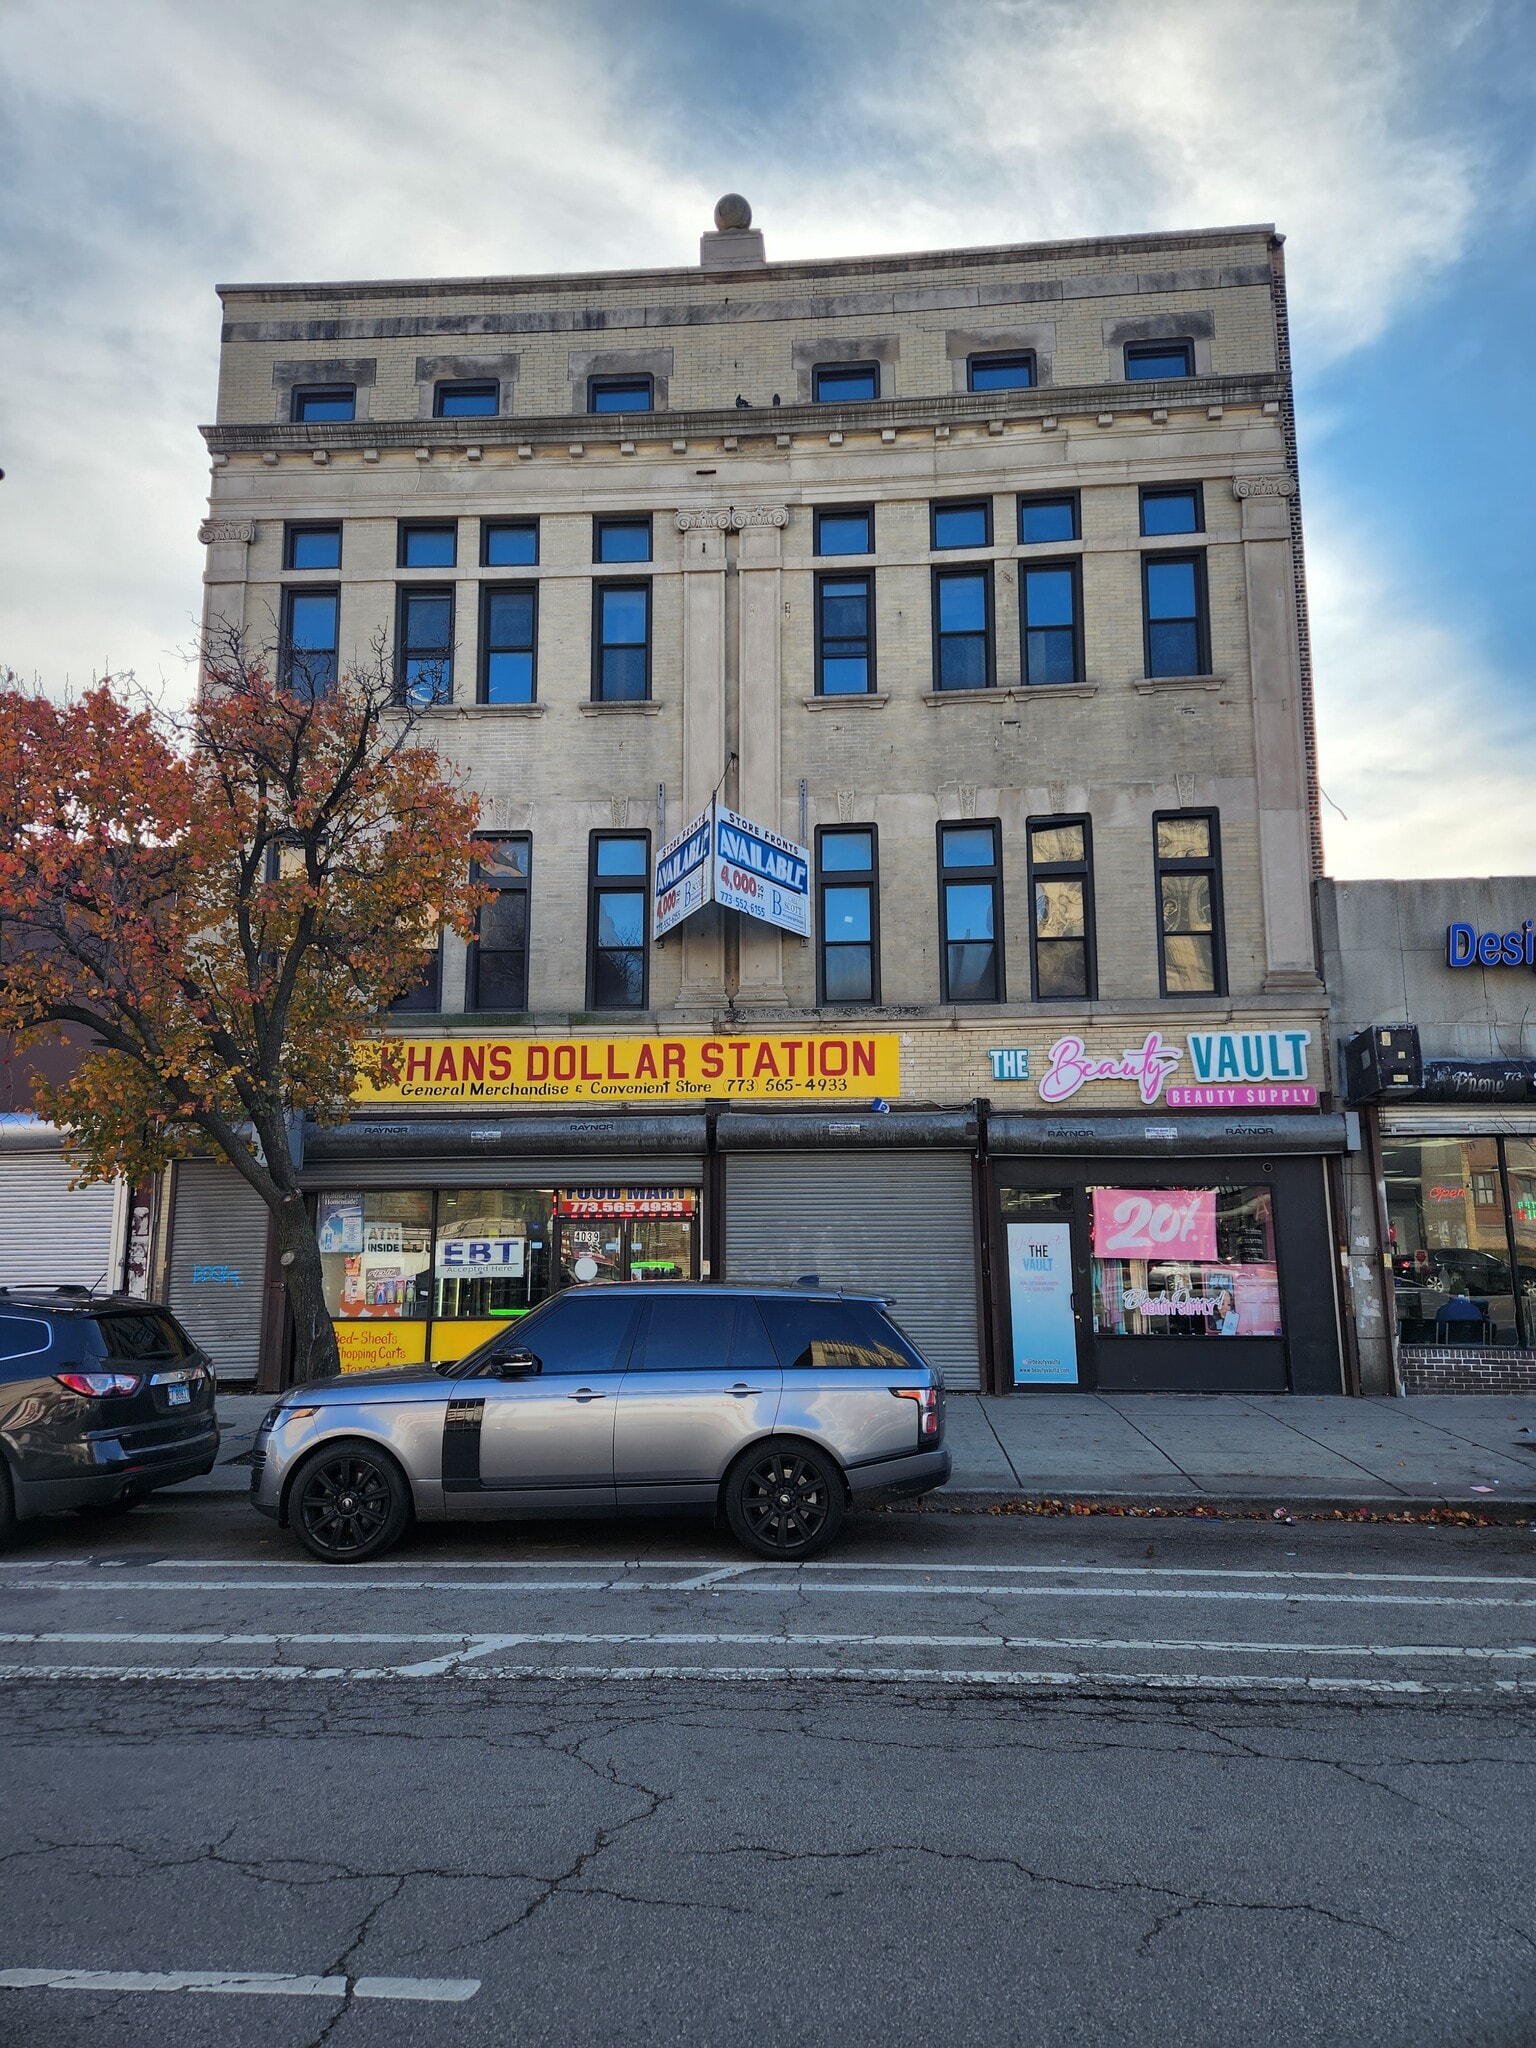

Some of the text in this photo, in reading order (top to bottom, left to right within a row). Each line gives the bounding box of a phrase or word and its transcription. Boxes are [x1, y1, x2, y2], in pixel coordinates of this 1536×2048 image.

[729, 812, 798, 855] STORE FRONTS
[663, 836, 681, 857] STORE
[657, 827, 710, 893] AVAILABLE
[720, 828, 806, 889] AVAILABLE
[720, 864, 756, 897] 4,000
[684, 880, 692, 909] B
[720, 890, 765, 916] 773-552-6155
[772, 888, 782, 916] B
[784, 902, 802, 916] SCOTT
[1449, 919, 1534, 967] Desi
[526, 1043, 686, 1081] DOLLAR
[701, 1040, 876, 1078] STATION
[990, 1050, 1028, 1078] THE
[1192, 1034, 1306, 1078] VAULT
[1042, 1035, 1180, 1100] Beauty
[401, 1082, 465, 1096] General
[470, 1082, 569, 1096] Merchandise
[590, 1080, 670, 1094] Convenient
[676, 1080, 712, 1093] Store
[722, 1078, 760, 1094] (773)
[766, 1078, 848, 1092] 565-4933
[1172, 1089, 1310, 1104] BEAUTY SUPPLY
[1048, 1130, 1094, 1138] RAYNOR
[1226, 1127, 1274, 1135] RAYNOR
[1430, 1186, 1466, 1202] Open
[570, 1202, 683, 1212] 773.565.4933
[368, 1228, 399, 1240] ATM
[575, 1231, 600, 1242] 4039
[368, 1244, 399, 1252] INSIDE
[444, 1241, 519, 1264] EBT
[1029, 1244, 1048, 1258] THE
[446, 1265, 489, 1274] Accepted
[1023, 1258, 1053, 1272] VAULT
[1140, 1302, 1216, 1316] BEAUTY SUPPLY
[338, 1347, 376, 1362] hopping
